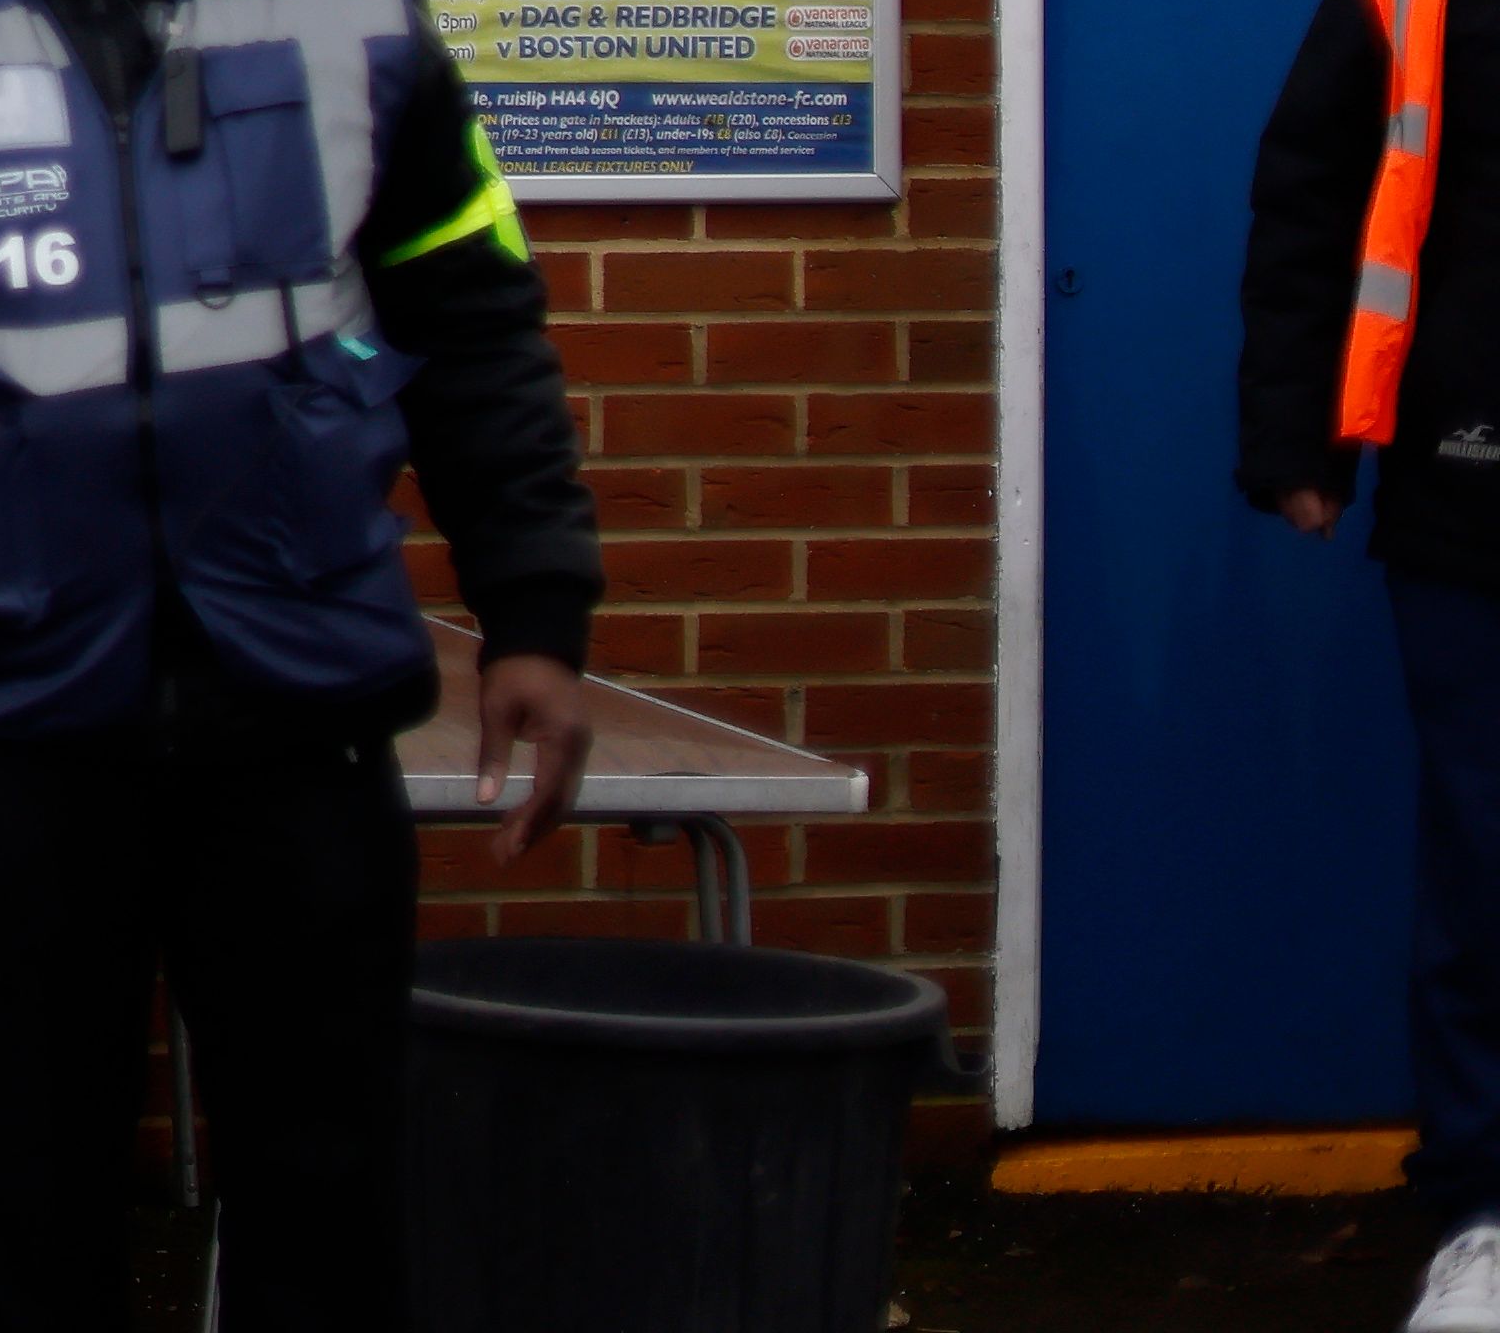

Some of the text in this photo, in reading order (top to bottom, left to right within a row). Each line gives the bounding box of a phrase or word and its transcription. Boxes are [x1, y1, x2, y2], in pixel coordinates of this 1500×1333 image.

[436, 6, 776, 32] (3pm) v DAG & REDBRIDGE
[497, 36, 756, 59] v BOSTON UNITED
[497, 90, 621, 109] ruislip HA4 6JQ
[652, 90, 848, 109] www.wealdstone-fc.com
[500, 114, 540, 127] (Prices
[543, 116, 558, 125] on
[560, 116, 586, 128] gate
[603, 114, 661, 127] brackets):
[663, 114, 701, 126] Adults
[762, 115, 829, 126] concessions
[501, 129, 538, 142] (19-23
[541, 131, 573, 142] years
[575, 128, 598, 141] old)
[656, 129, 715, 140] under-19s
[734, 129, 761, 142] (also
[543, 161, 694, 173] LEAGUE FIXTURES ONLY
